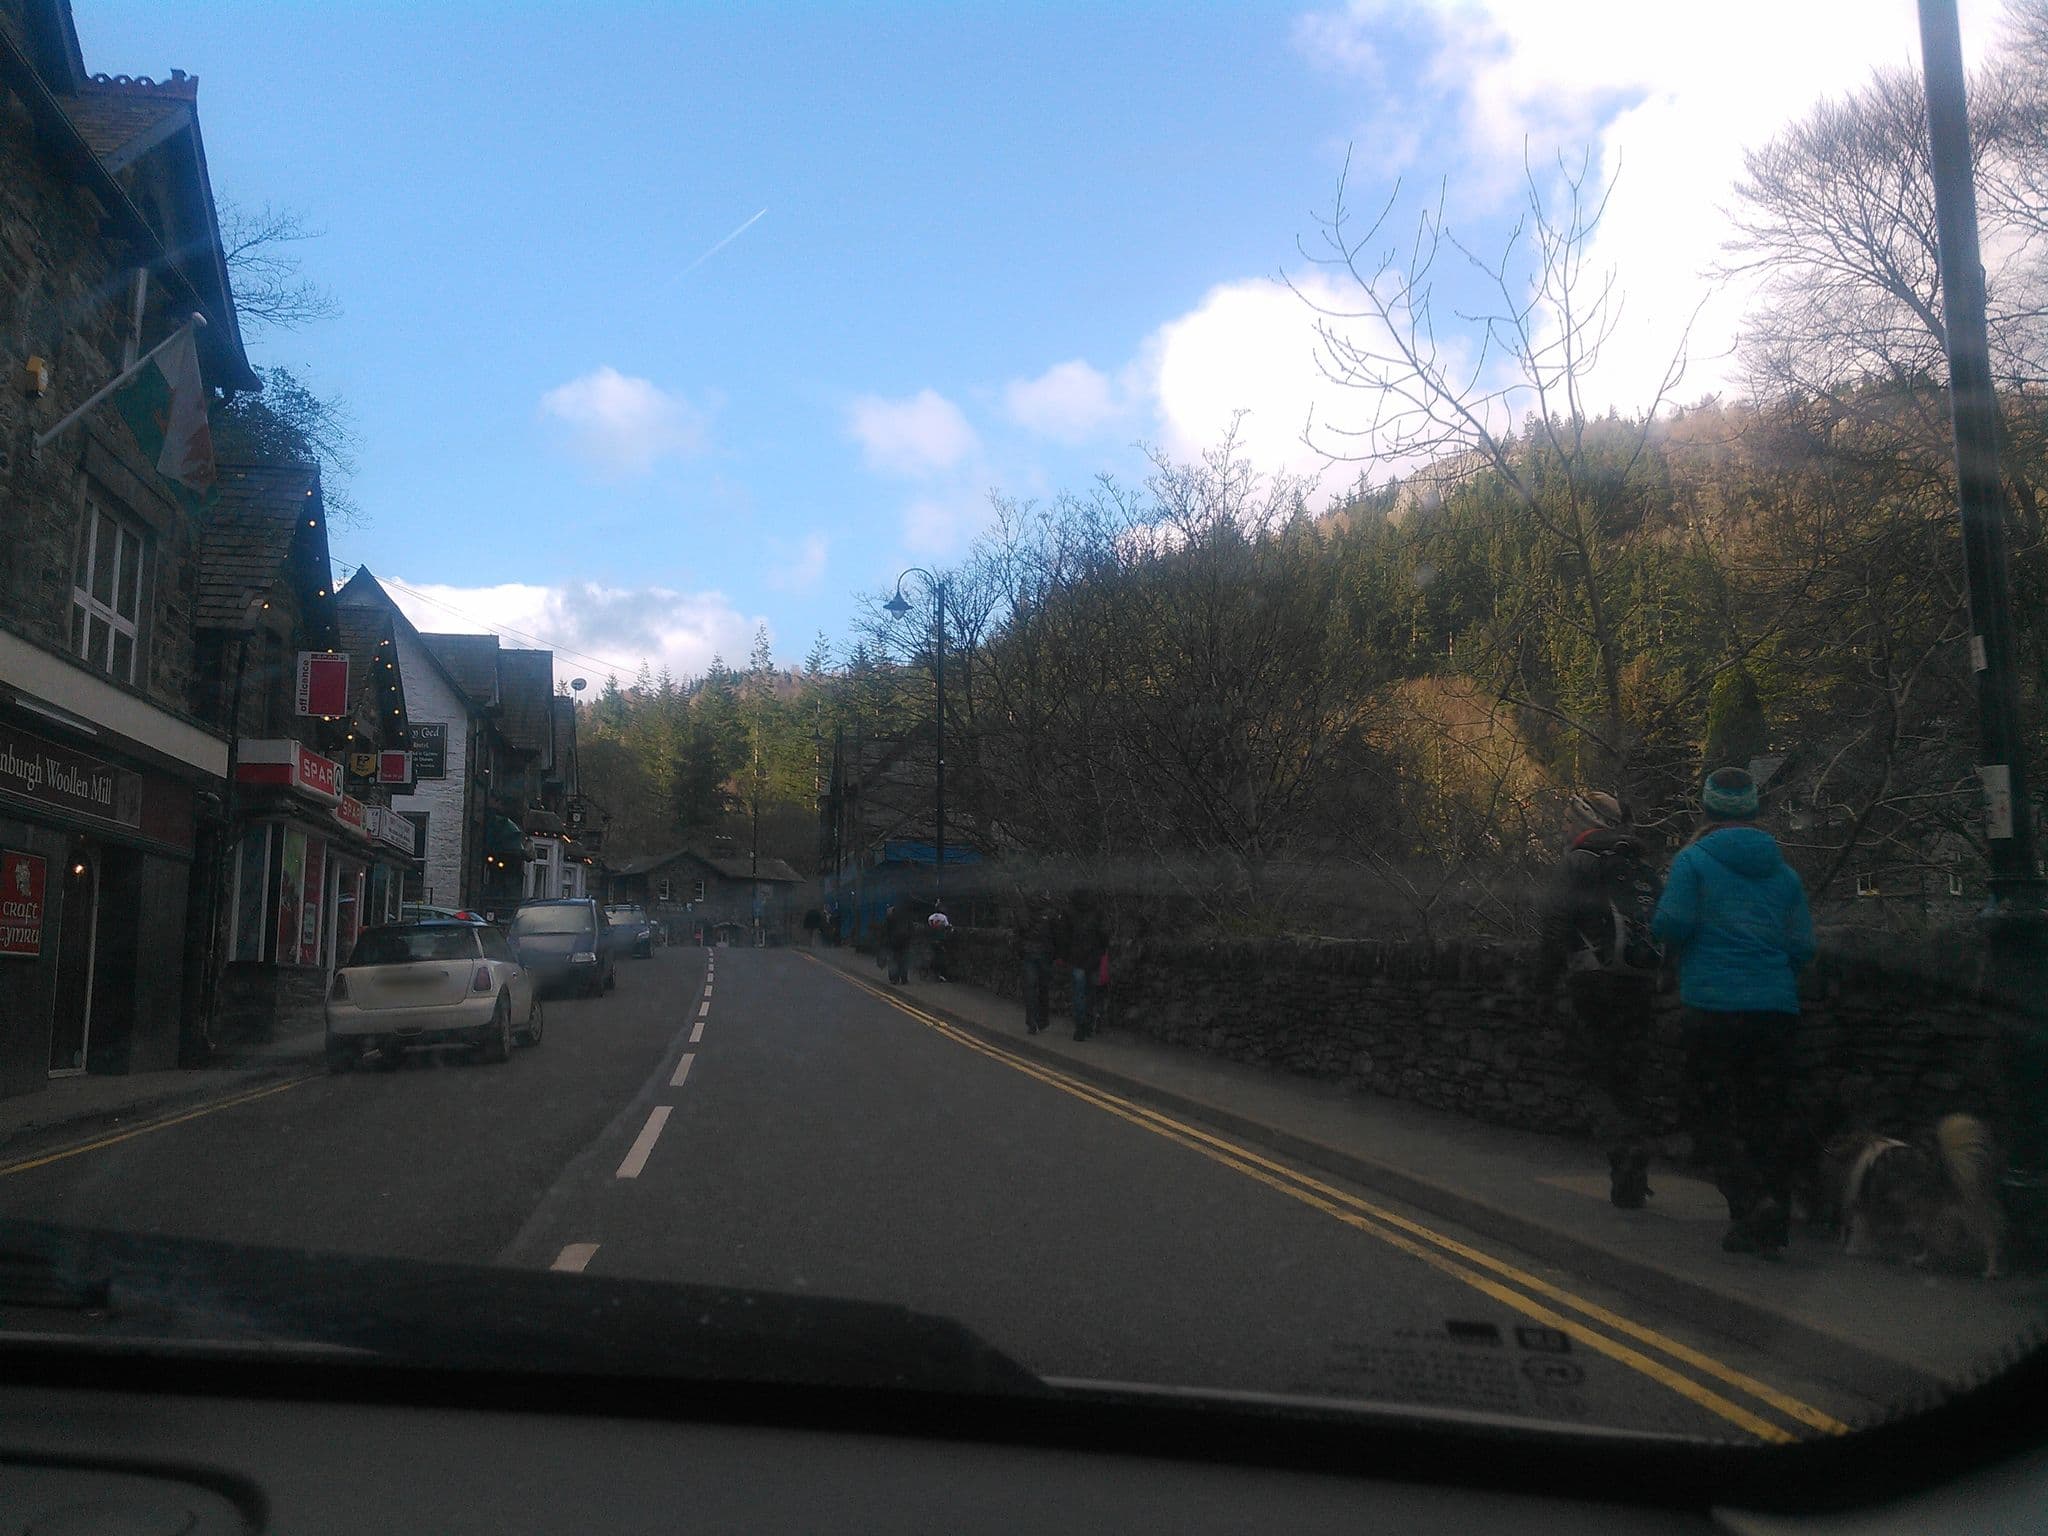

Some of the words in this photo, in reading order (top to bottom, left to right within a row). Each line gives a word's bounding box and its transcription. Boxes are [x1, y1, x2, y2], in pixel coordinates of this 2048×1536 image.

[299, 660, 310, 697] licence
[299, 698, 308, 712] off
[46, 756, 89, 799] Woollen
[90, 774, 112, 805] Mill
[303, 758, 334, 786] SPAR
[342, 801, 361, 818] SPAR
